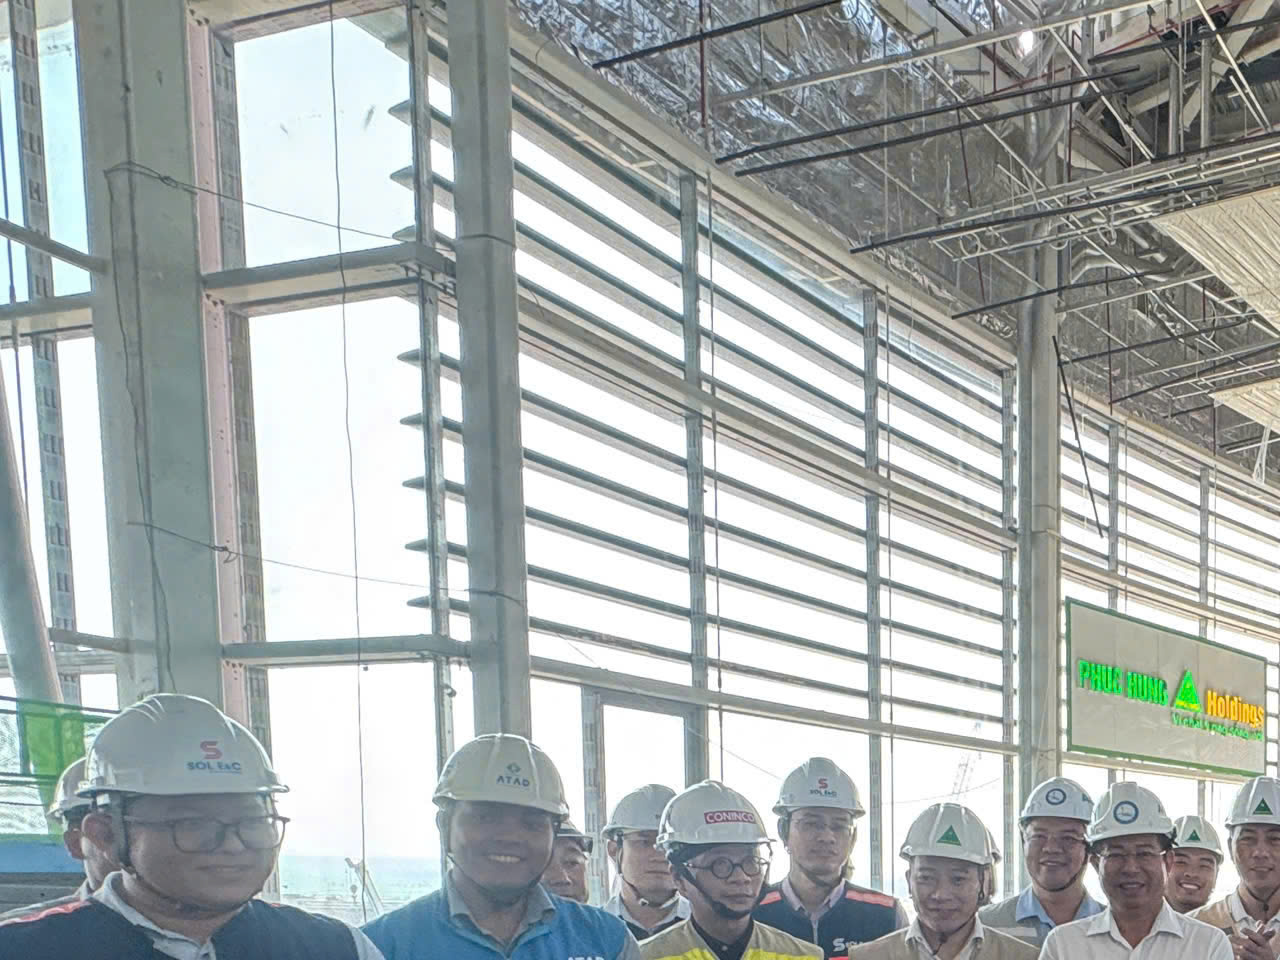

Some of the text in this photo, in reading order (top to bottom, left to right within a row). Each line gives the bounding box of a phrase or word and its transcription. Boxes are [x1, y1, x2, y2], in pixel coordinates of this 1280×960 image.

[1207, 689, 1264, 728] Holdings
[187, 761, 213, 771] SOL
[497, 775, 530, 787] ATAD
[706, 812, 755, 823] CONINCO
